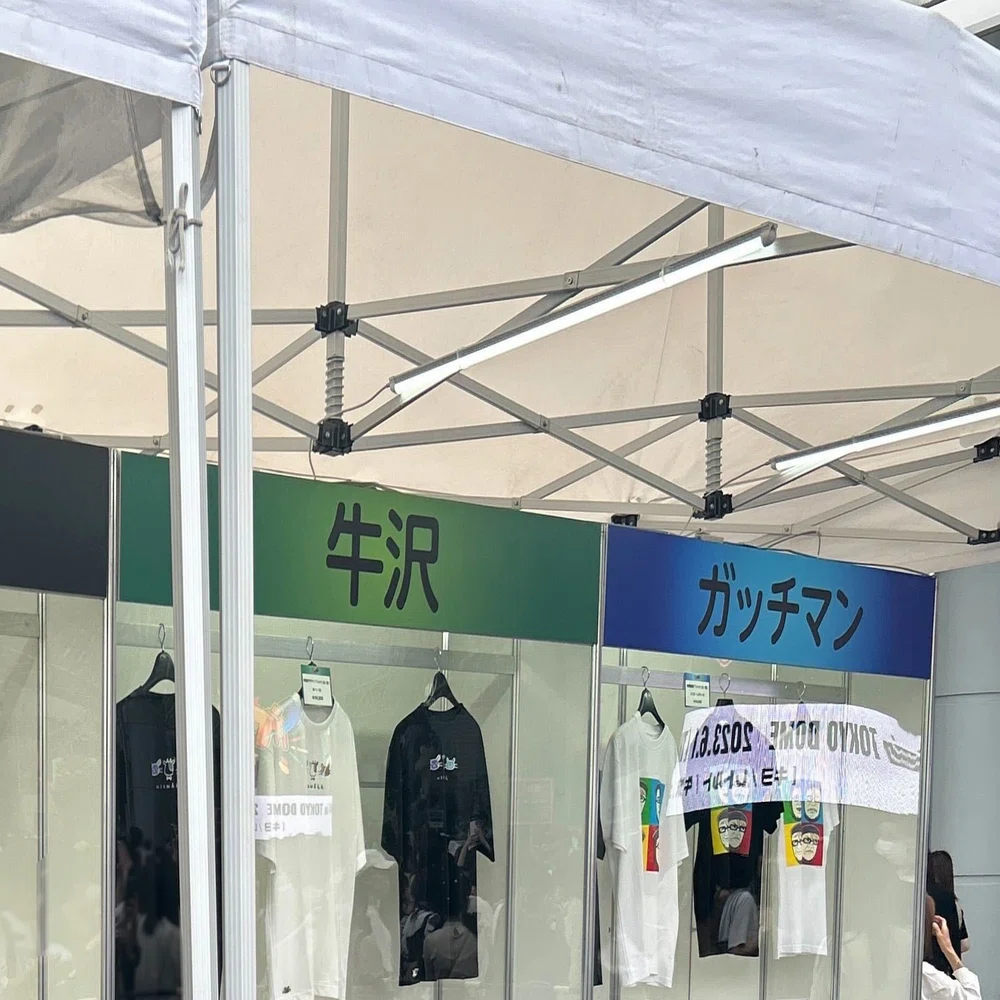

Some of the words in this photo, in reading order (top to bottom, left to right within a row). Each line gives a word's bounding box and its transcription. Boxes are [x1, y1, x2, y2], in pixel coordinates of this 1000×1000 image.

[326, 501, 440, 613] 牛沢
[697, 562, 864, 651] ガッチマン
